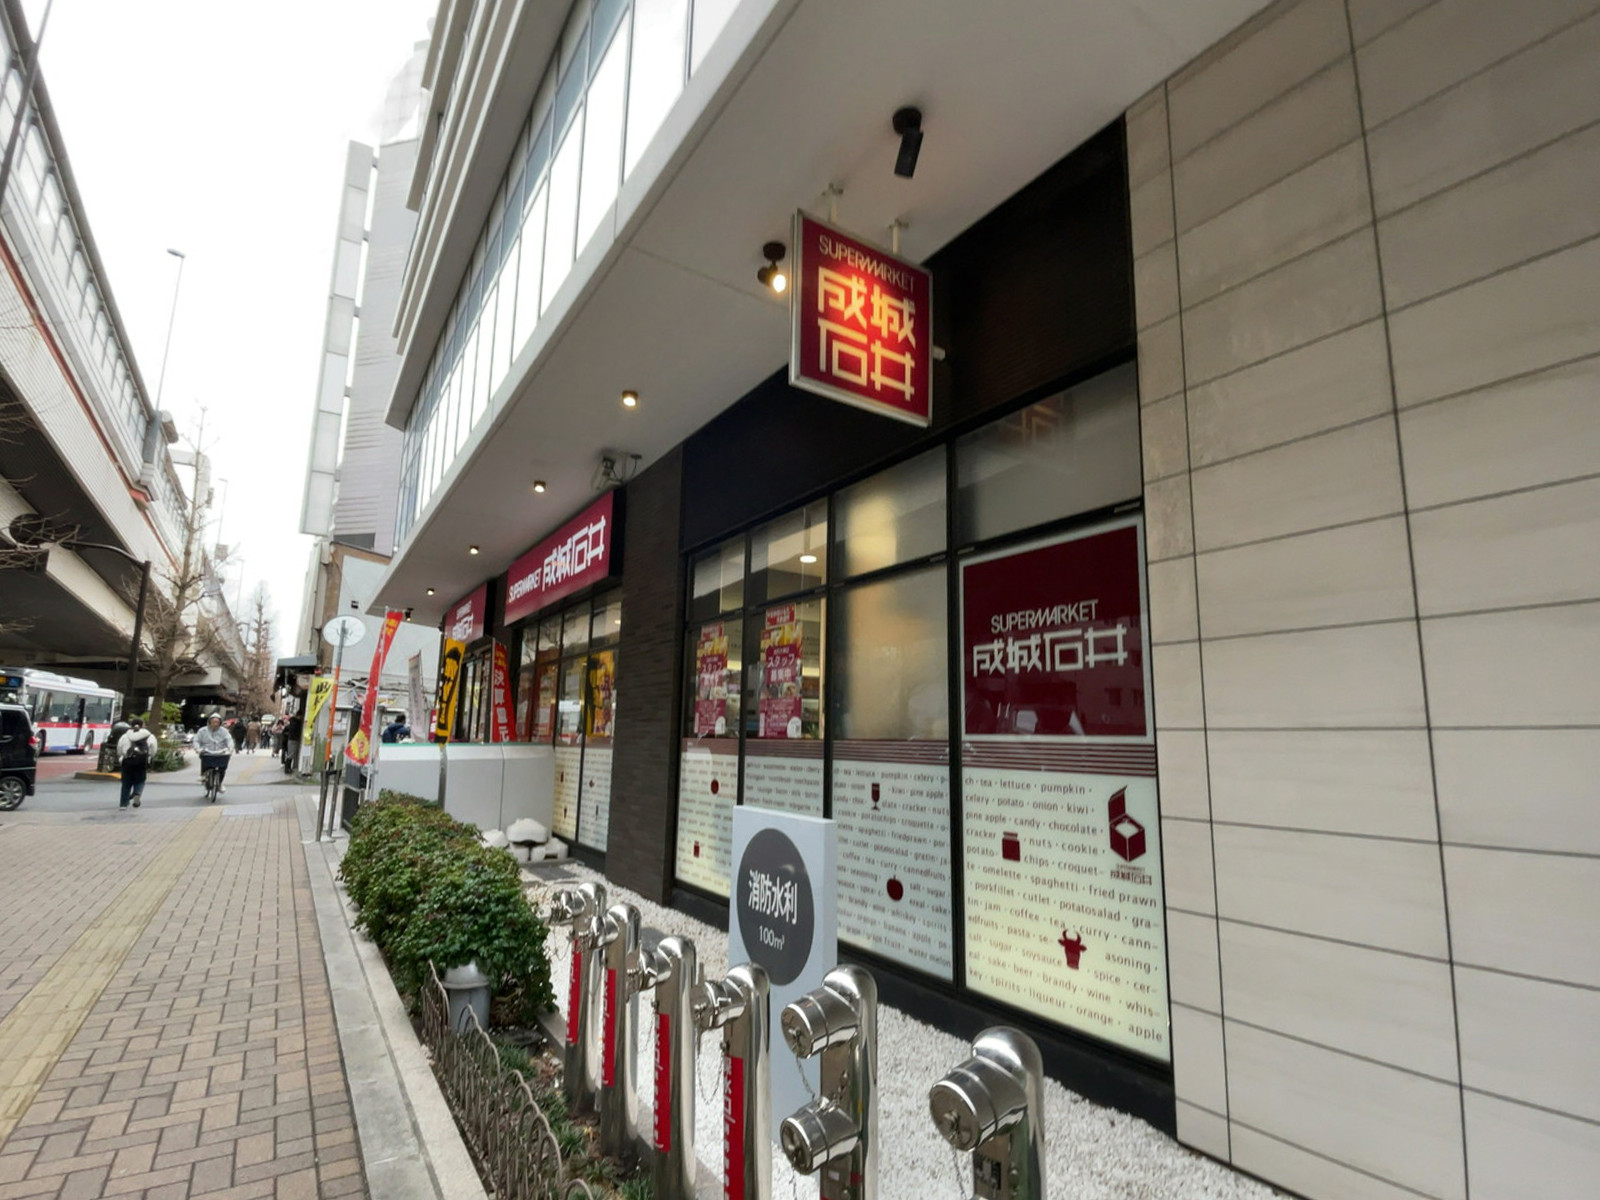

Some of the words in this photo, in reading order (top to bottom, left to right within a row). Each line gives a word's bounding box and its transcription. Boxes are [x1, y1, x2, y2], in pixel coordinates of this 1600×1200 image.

[819, 235, 915, 292] SUPERMARKET
[818, 266, 916, 349] 成城
[818, 318, 915, 401] 石井
[508, 567, 542, 603] SUPERMARKET
[541, 515, 606, 592] 成城石井
[991, 599, 1099, 634] SUPERMARKET
[973, 624, 1128, 677] 成城石井
[966, 793, 990, 805] celery
[997, 798, 1025, 808] potato
[1032, 800, 1058, 811] onion
[1066, 803, 1089, 814] kiwi
[1000, 779, 1031, 790] lettuce
[1041, 783, 1085, 795] pumpkin
[966, 811, 982, 820] pine
[985, 814, 1006, 824] apple
[1014, 817, 1041, 830] candy
[1048, 820, 1097, 835] chocolate
[966, 828, 996, 839] cracker
[1029, 838, 1052, 849] nuts
[1061, 842, 1099, 855] cookie
[1024, 854, 1049, 867] chips
[748, 869, 798, 925] 消防水利
[975, 881, 1014, 897] porkfillet
[1022, 892, 1050, 905] cutlet
[1060, 900, 1120, 922] potatosalad
[982, 865, 1021, 880] omelette
[1030, 874, 1078, 892] spaghetti
[1089, 884, 1115, 900] fried
[1119, 892, 1157, 908] prawn
[984, 901, 1001, 912] jam
[1009, 907, 1040, 921] coffee
[1079, 925, 1110, 942] curry
[1007, 926, 1031, 938] pasta
[1105, 952, 1151, 974] asoning
[1013, 963, 1033, 978] beer
[1042, 972, 1078, 994] brandy
[1087, 988, 1111, 1003] wine
[1094, 970, 1121, 985] spice
[991, 975, 1021, 993] spirits
[1029, 987, 1066, 1009] liqueur
[1076, 1006, 1114, 1025] orange
[1128, 1024, 1163, 1042] apple
